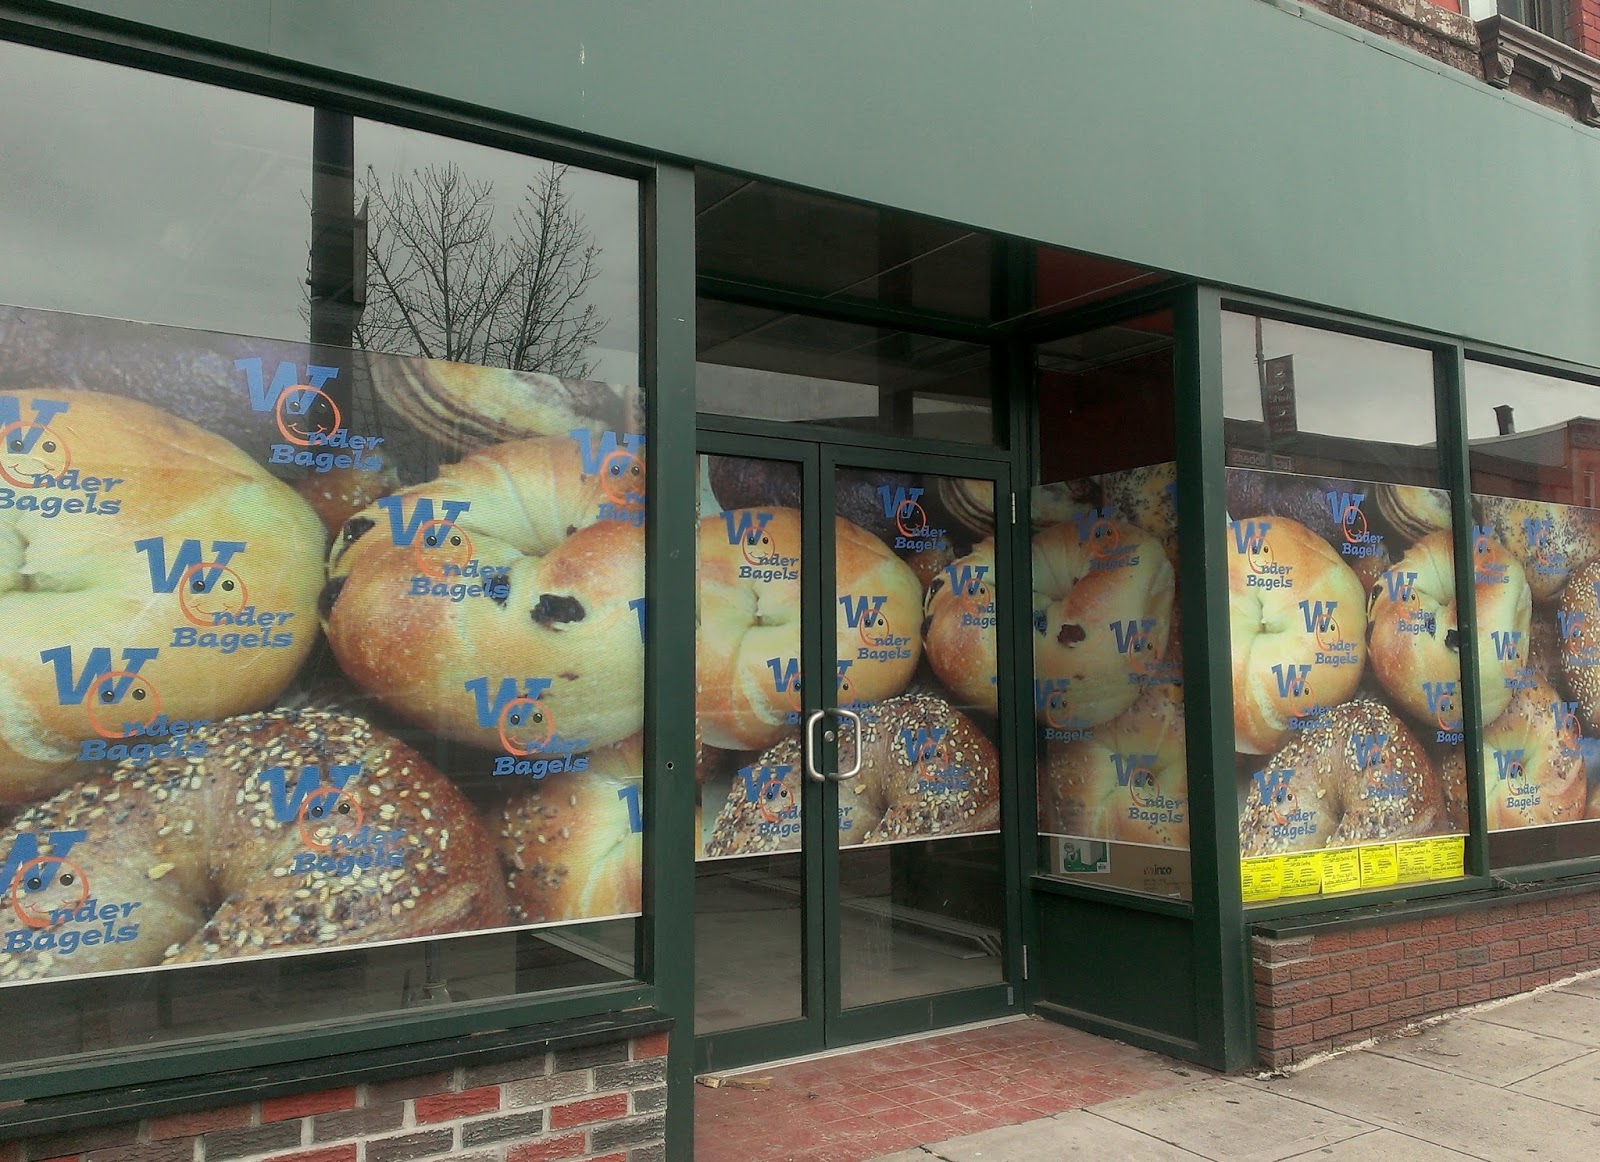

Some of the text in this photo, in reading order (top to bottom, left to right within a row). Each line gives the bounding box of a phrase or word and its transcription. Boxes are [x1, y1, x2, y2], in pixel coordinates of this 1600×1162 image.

[269, 444, 382, 474] Bagels
[0, 488, 123, 519] Bagels
[596, 503, 645, 527] Bag
[894, 537, 948, 552] Bagels
[1342, 542, 1384, 559] Bagels
[739, 565, 799, 583] Bagels
[1246, 574, 1293, 590] Bagels
[407, 577, 511, 603] Bagels
[960, 614, 997, 629] Bage
[1397, 618, 1437, 635] Bagels
[169, 626, 294, 655] Bagels
[856, 646, 912, 663] Bagels
[1315, 650, 1358, 667] Bagels
[1044, 727, 1094, 744] Bagels
[1436, 730, 1464, 745] Bage
[76, 738, 209, 763] Bagels
[492, 753, 590, 780] Bagels
[1506, 794, 1541, 811] Bagels
[1128, 807, 1184, 824] Bagels
[1271, 822, 1317, 839] Bagels
[290, 847, 407, 876] Bagels
[2, 920, 140, 955] Bagels
